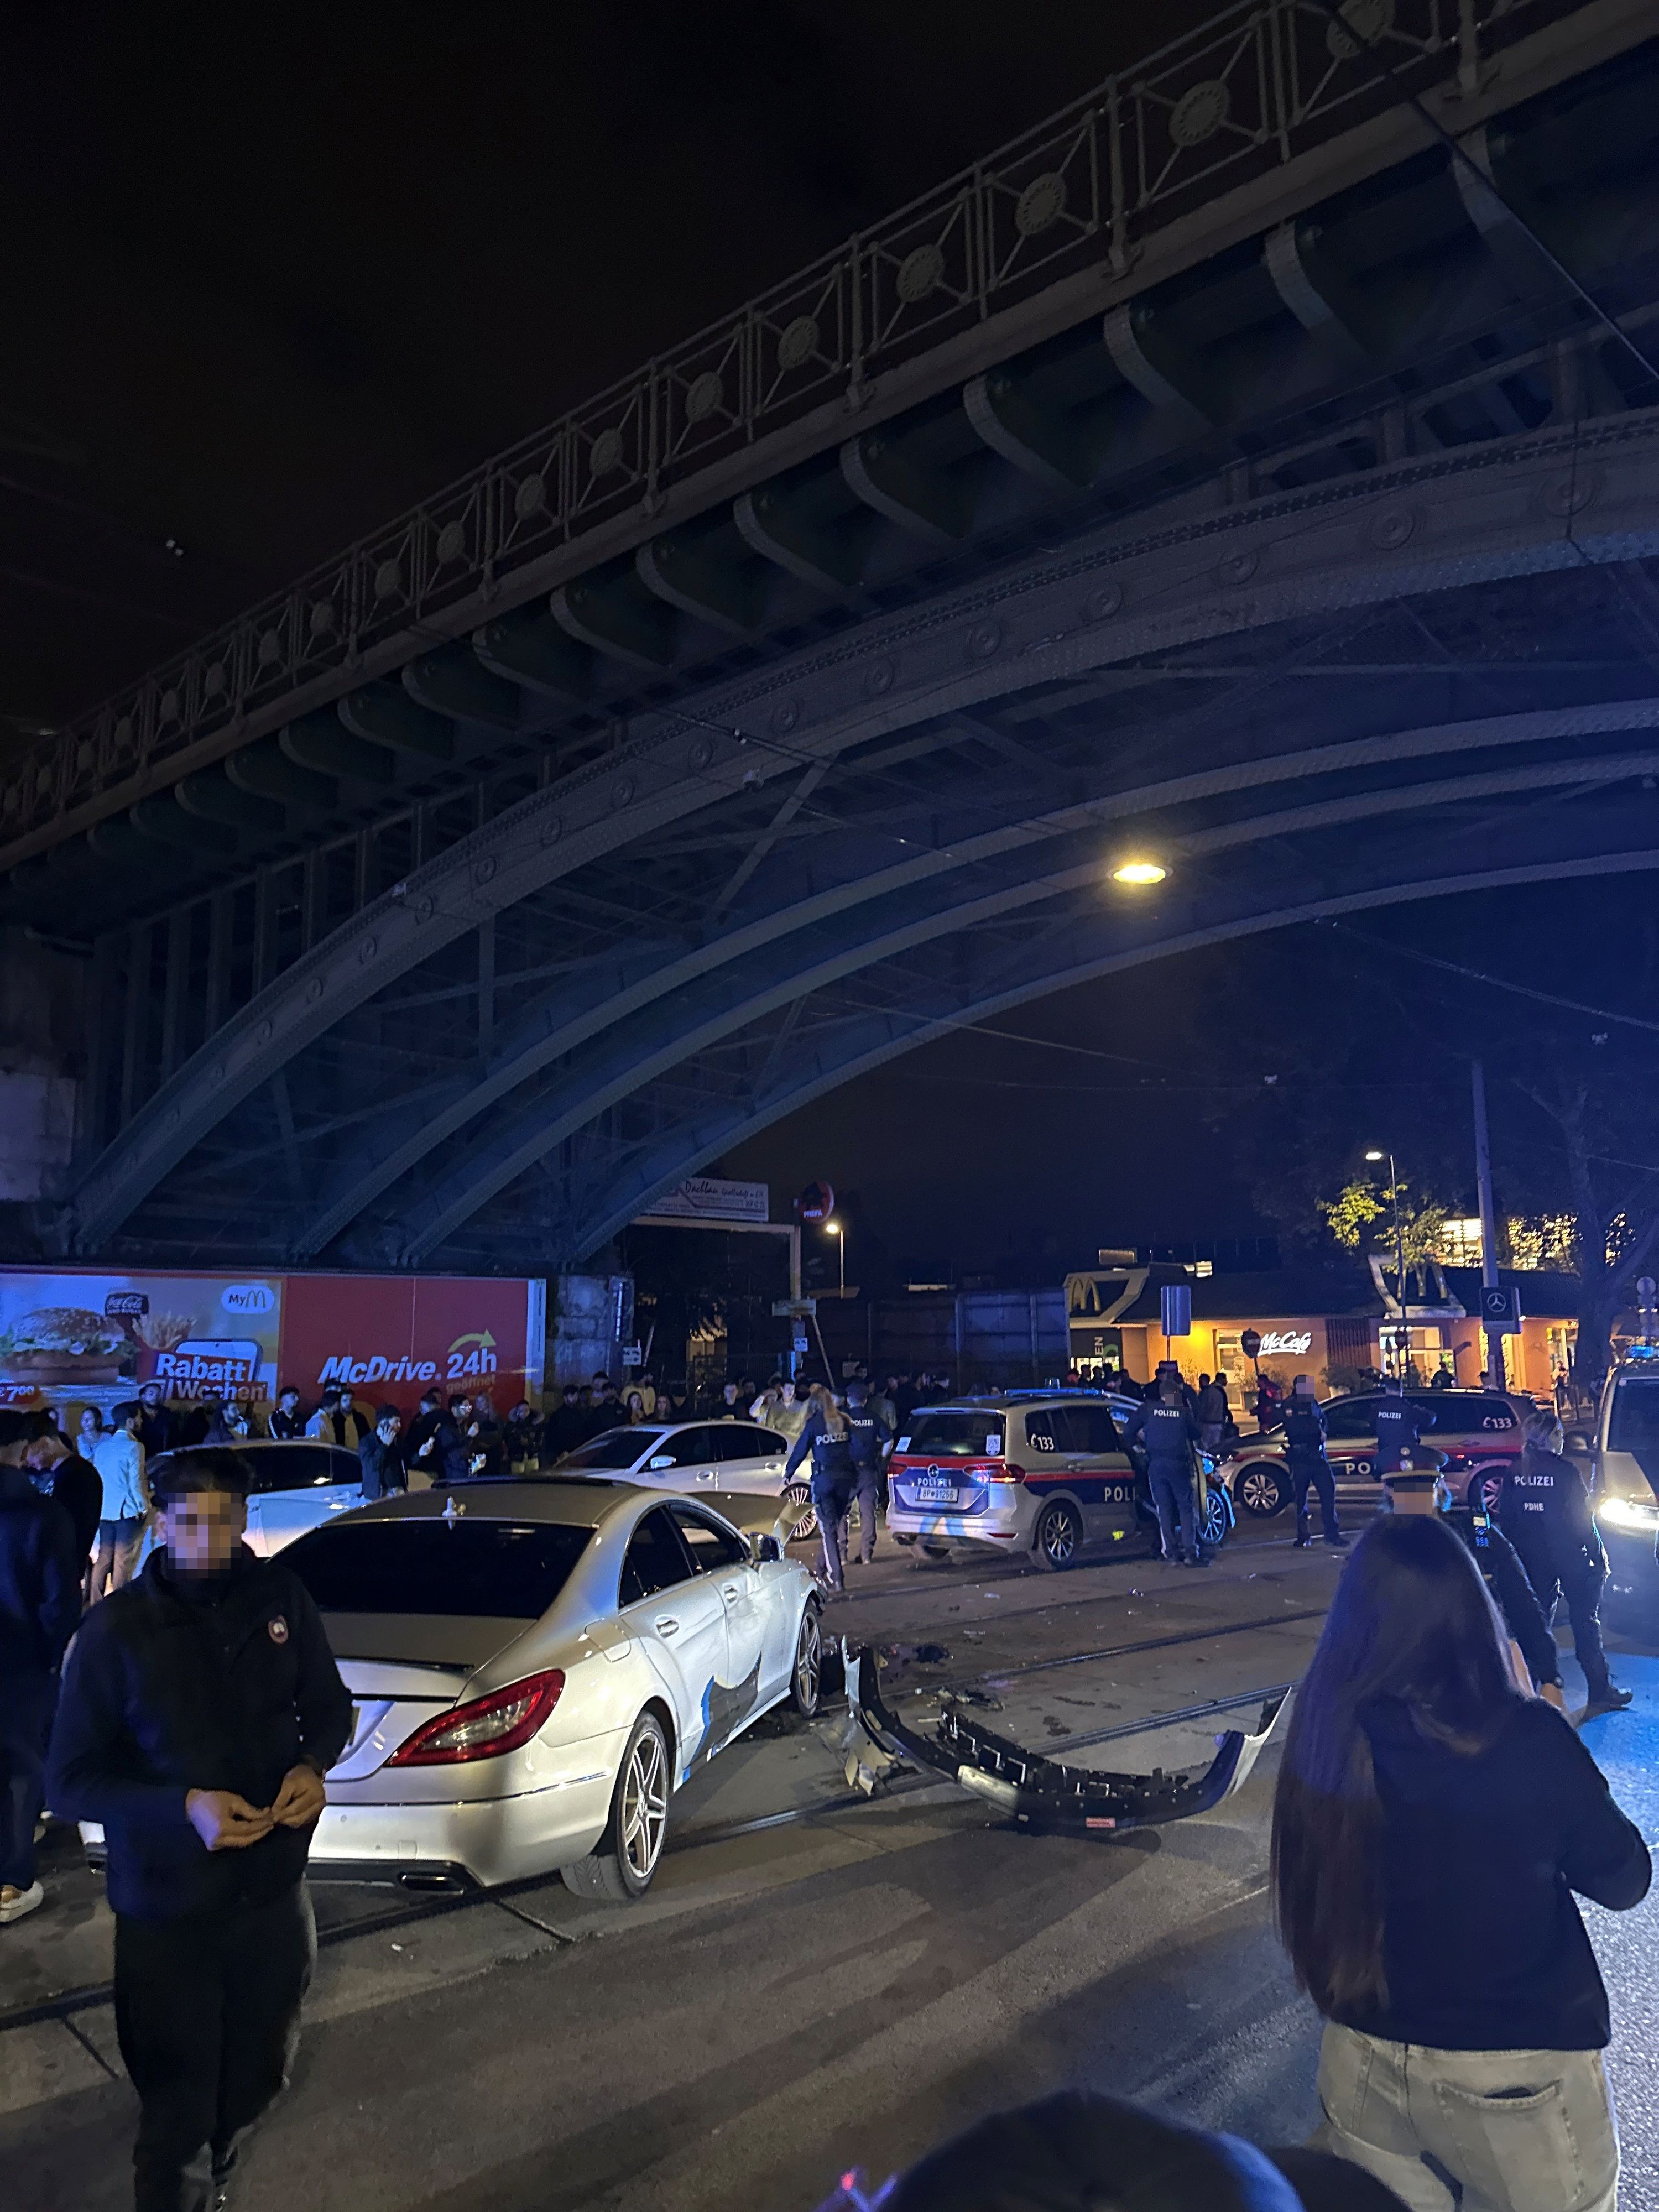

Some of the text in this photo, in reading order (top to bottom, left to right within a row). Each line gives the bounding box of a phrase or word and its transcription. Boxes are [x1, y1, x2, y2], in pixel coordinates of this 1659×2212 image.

[155, 1353, 247, 1381] Rabatt
[447, 1348, 497, 1379] 24h
[1154, 1409, 1180, 1418] POLIZEI
[1378, 1411, 1401, 1420] POLIZEI
[1491, 1418, 1512, 1429] 133
[816, 1432, 849, 1446] POLIZE
[1037, 1436, 1055, 1451] 133
[917, 1477, 952, 1487] POLIZEI
[1514, 1475, 1554, 1486] POLIZEI
[1104, 1486, 1135, 1502] POLI
